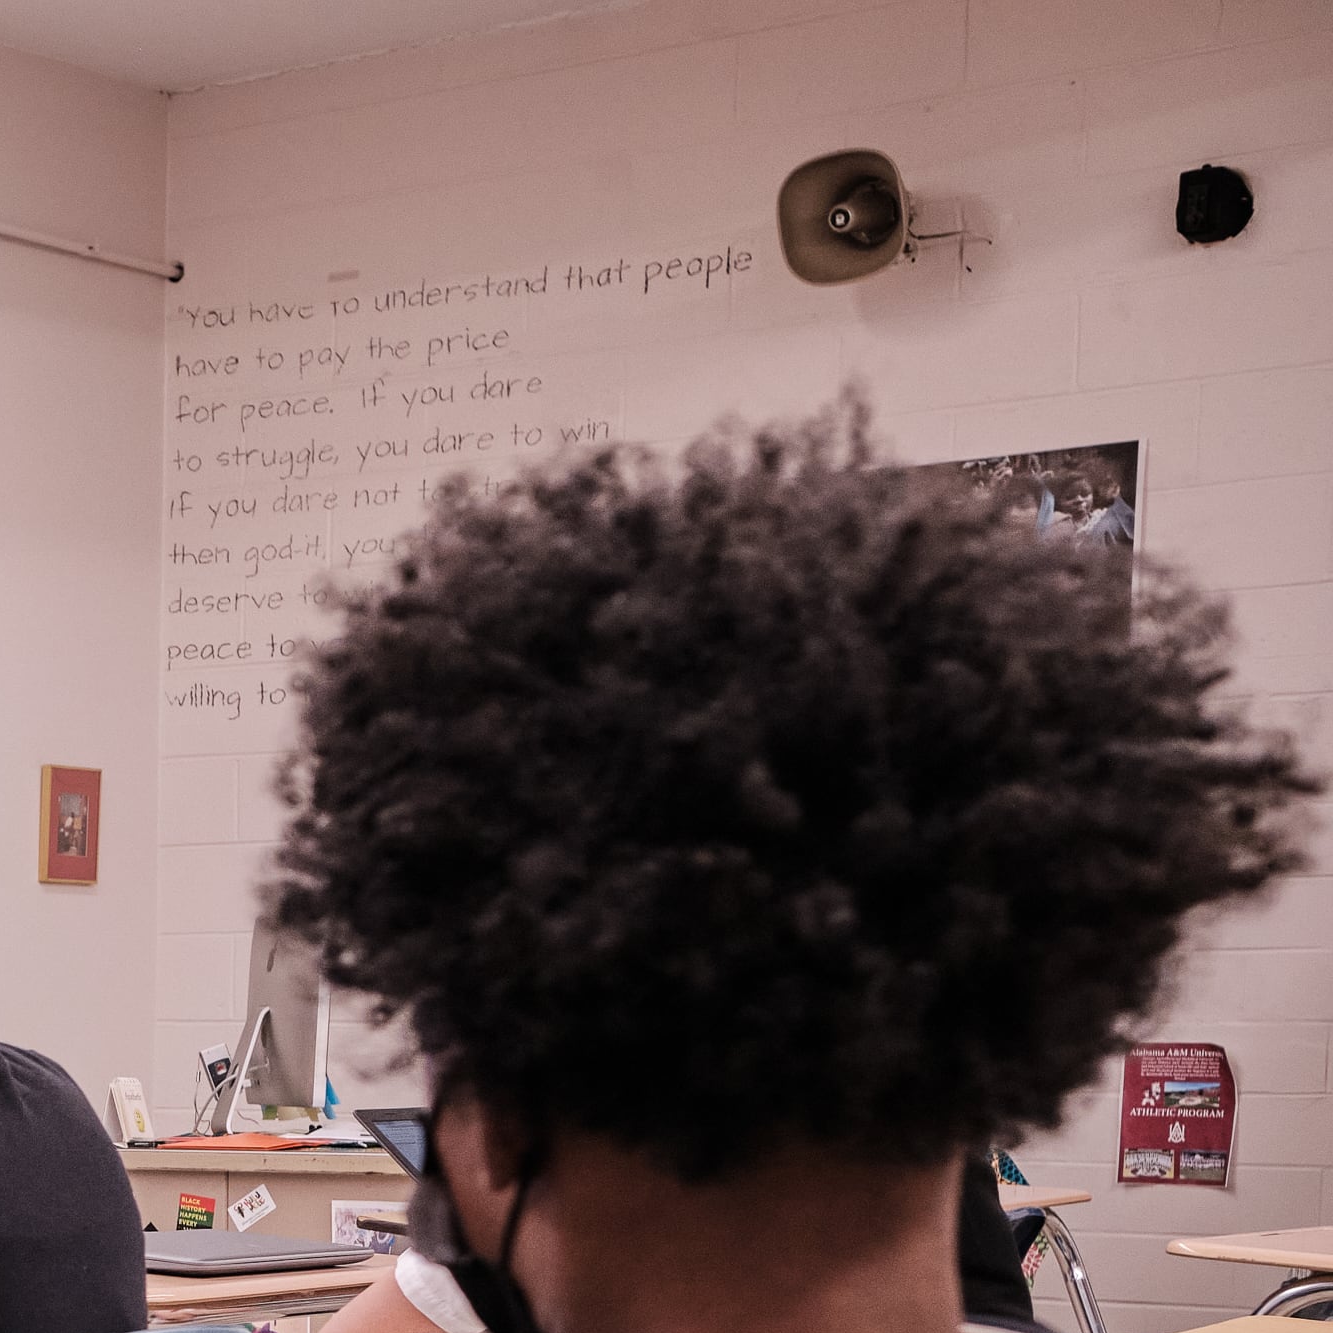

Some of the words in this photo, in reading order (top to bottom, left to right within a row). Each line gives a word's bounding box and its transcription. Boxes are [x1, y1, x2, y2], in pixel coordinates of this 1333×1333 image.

[247, 301, 315, 324] have
[331, 294, 360, 316] to
[373, 268, 547, 314] understand
[563, 258, 631, 291] that
[643, 245, 753, 295] people
[175, 353, 239, 377] have
[255, 349, 283, 372] to
[299, 345, 351, 374] pay
[366, 335, 411, 360] the
[427, 327, 510, 366] price
[175, 396, 227, 425] for
[362, 378, 388, 409] If
[401, 384, 455, 416] you
[469, 374, 542, 400] dare
[173, 448, 202, 472] to
[356, 431, 409, 462] you
[422, 425, 495, 455] dare
[510, 423, 542, 445] to
[560, 419, 609, 443] win
[208, 499, 257, 528] you
[273, 486, 338, 514] dare
[353, 482, 401, 507] not
[169, 542, 230, 565] then
[168, 588, 284, 615] deserve
[303, 584, 329, 612] to
[167, 639, 253, 671] peace
[266, 635, 296, 658] to
[165, 682, 241, 721] willing
[257, 682, 286, 705] to
[1130, 1107, 1175, 1116] ATHLETIC
[1178, 1108, 1224, 1118] PROGRAM
[180, 1205, 206, 1213] HISTORY
[180, 1211, 207, 1221] HAPPENS
[182, 1197, 201, 1205] BLACK
[179, 1219, 197, 1227] EVERY
